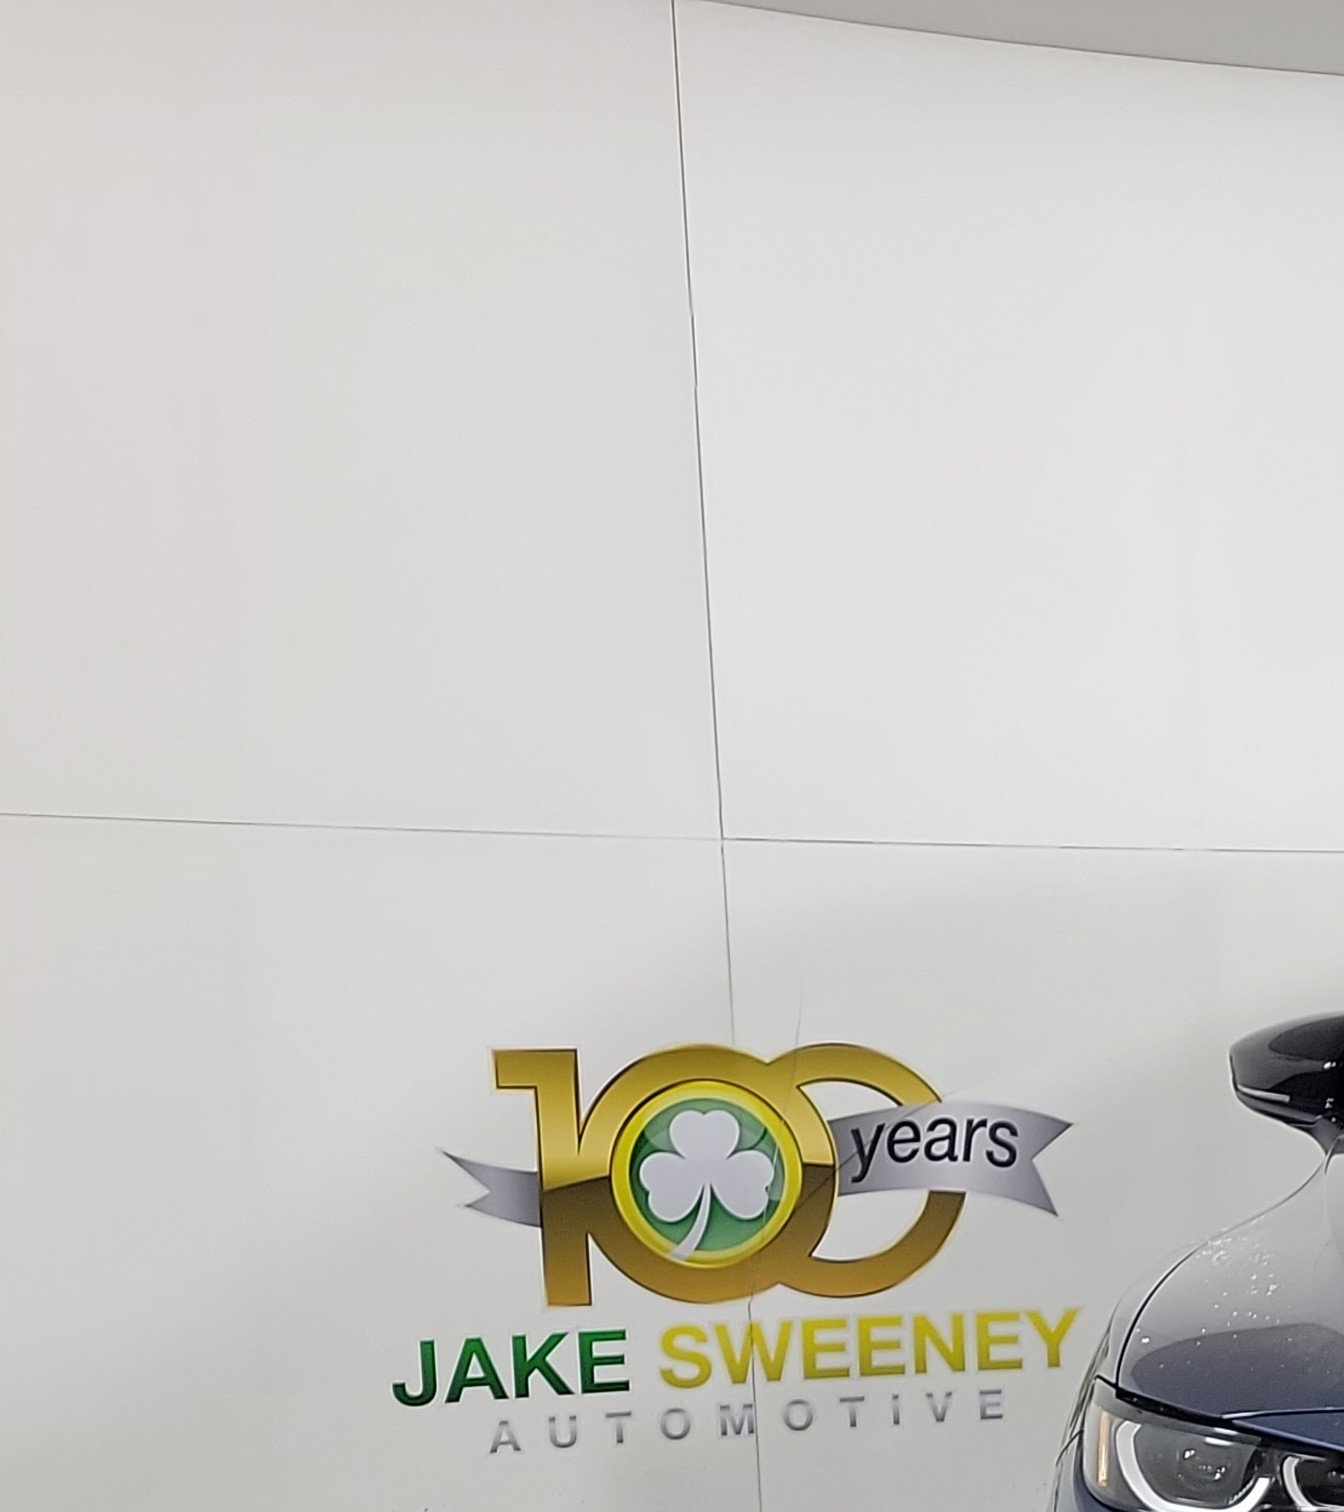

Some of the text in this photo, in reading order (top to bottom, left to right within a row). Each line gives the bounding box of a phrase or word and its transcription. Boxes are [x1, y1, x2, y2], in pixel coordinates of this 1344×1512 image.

[491, 1042, 1020, 1307] 100 years
[392, 1309, 1080, 1407] JAKE SWEENEY
[489, 1389, 1004, 1455] AUTOMOTIVE
